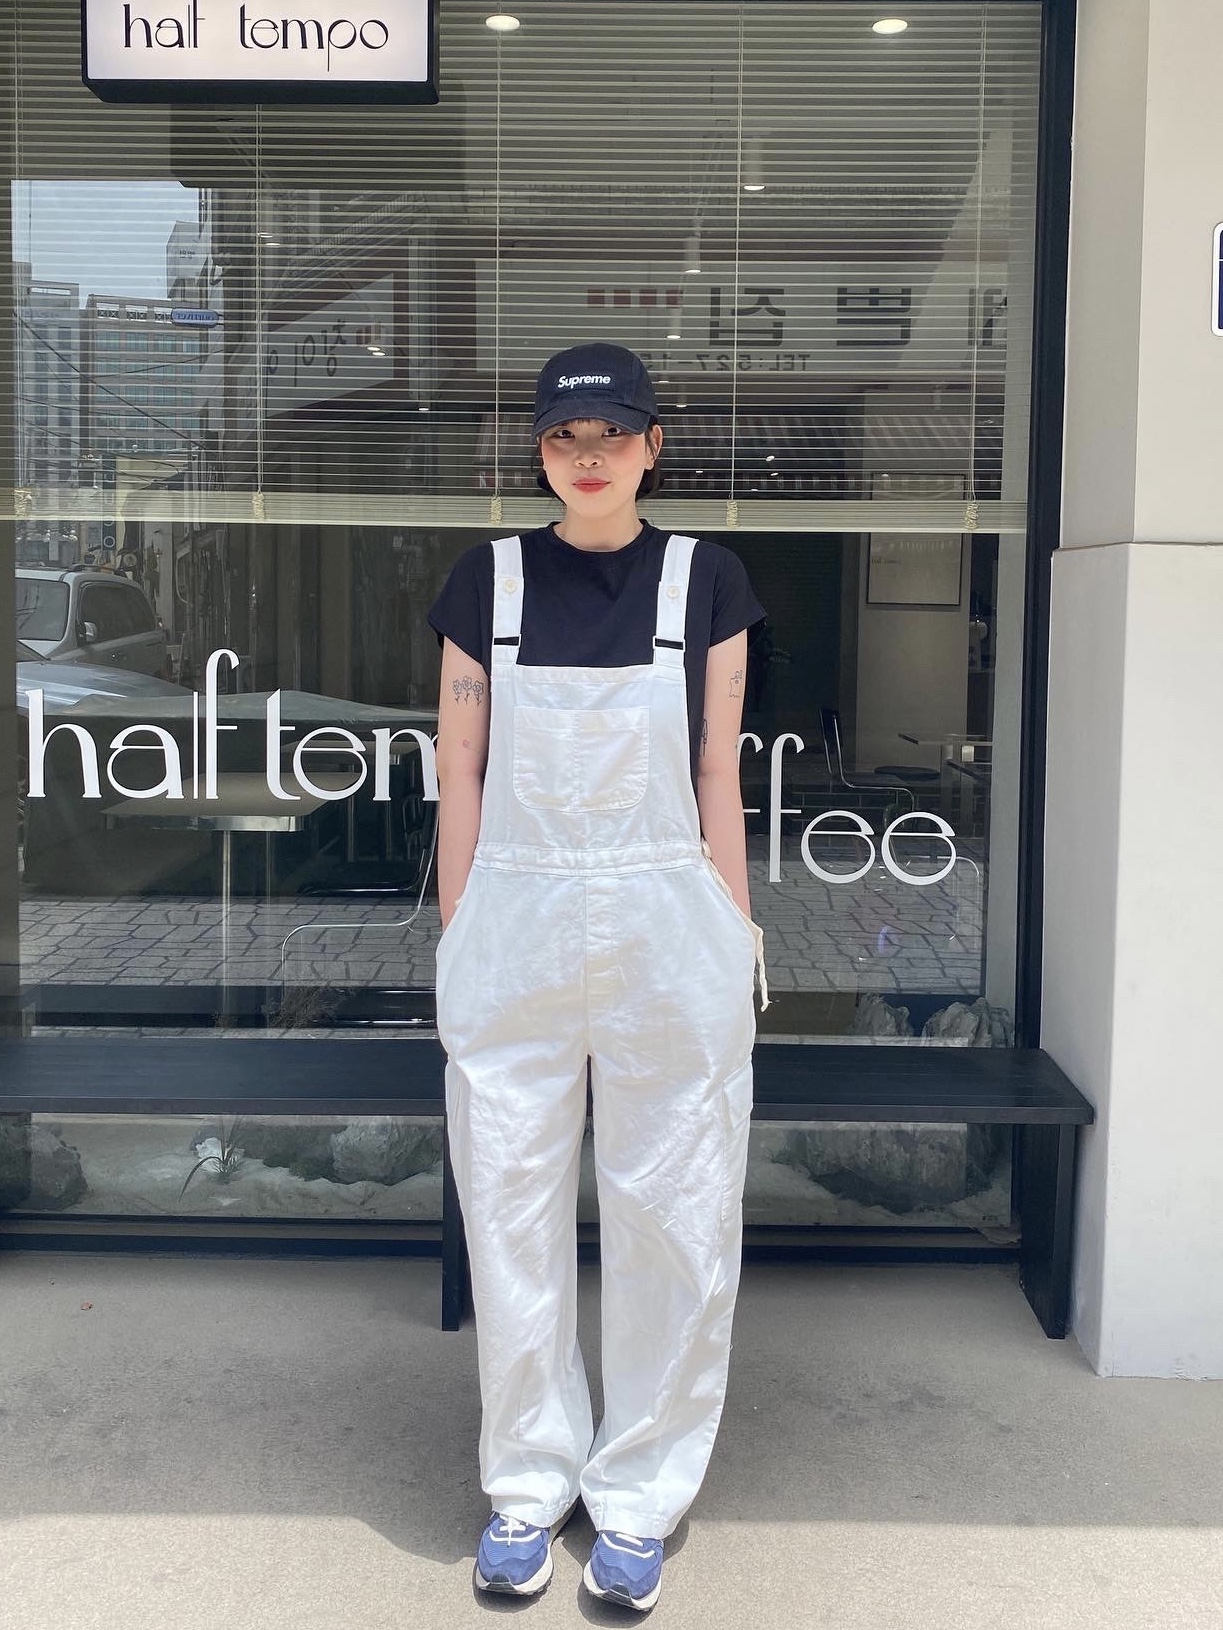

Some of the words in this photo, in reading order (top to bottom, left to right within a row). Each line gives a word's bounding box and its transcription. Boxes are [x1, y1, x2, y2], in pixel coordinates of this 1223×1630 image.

[239, 3, 389, 72] tempo
[557, 375, 612, 389] Supreme
[25, 648, 240, 800] half
